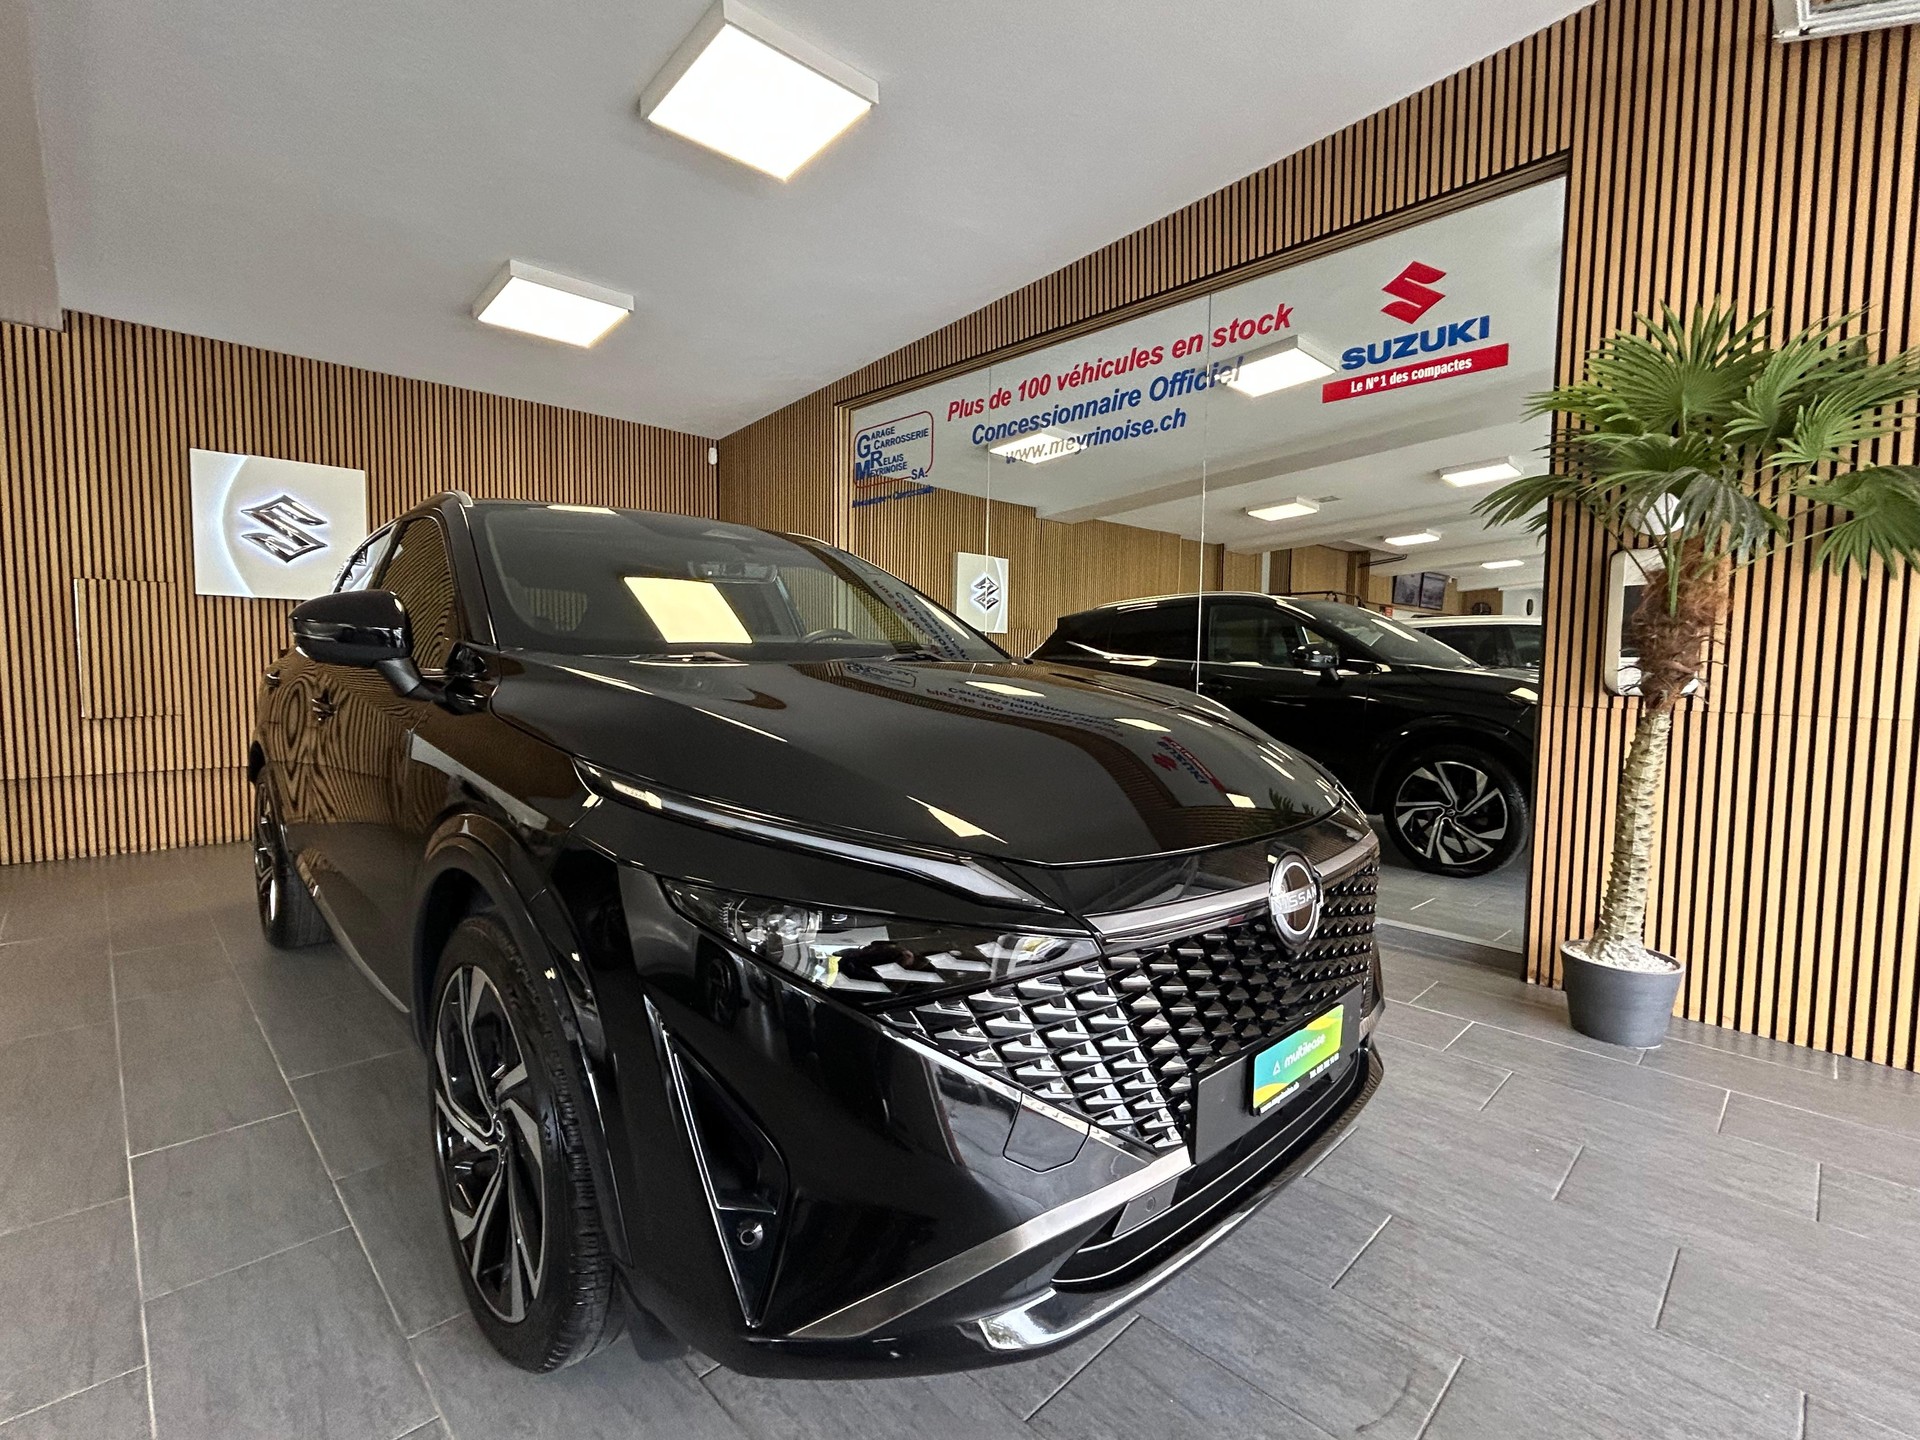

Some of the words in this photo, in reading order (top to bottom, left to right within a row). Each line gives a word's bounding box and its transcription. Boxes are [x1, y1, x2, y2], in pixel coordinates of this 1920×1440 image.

[947, 398, 985, 422] Plus
[989, 388, 1012, 410] de
[1018, 374, 1051, 401] 100
[1057, 345, 1164, 391] véhicules
[1171, 334, 1204, 359] en
[1211, 303, 1294, 348] stock
[1341, 315, 1490, 371] SUZUKI
[1350, 380, 1363, 393] Le
[1389, 370, 1409, 385] des
[1411, 357, 1473, 381] compactes
[972, 388, 1141, 445] Concessionnaire
[1150, 356, 1244, 402] Officiel
[870, 450, 905, 468] RELAIS
[874, 428, 929, 450] CARROSSERIE
[1005, 407, 1187, 465] www.meyrinoise.ch
[1272, 884, 1317, 914] NISSAN
